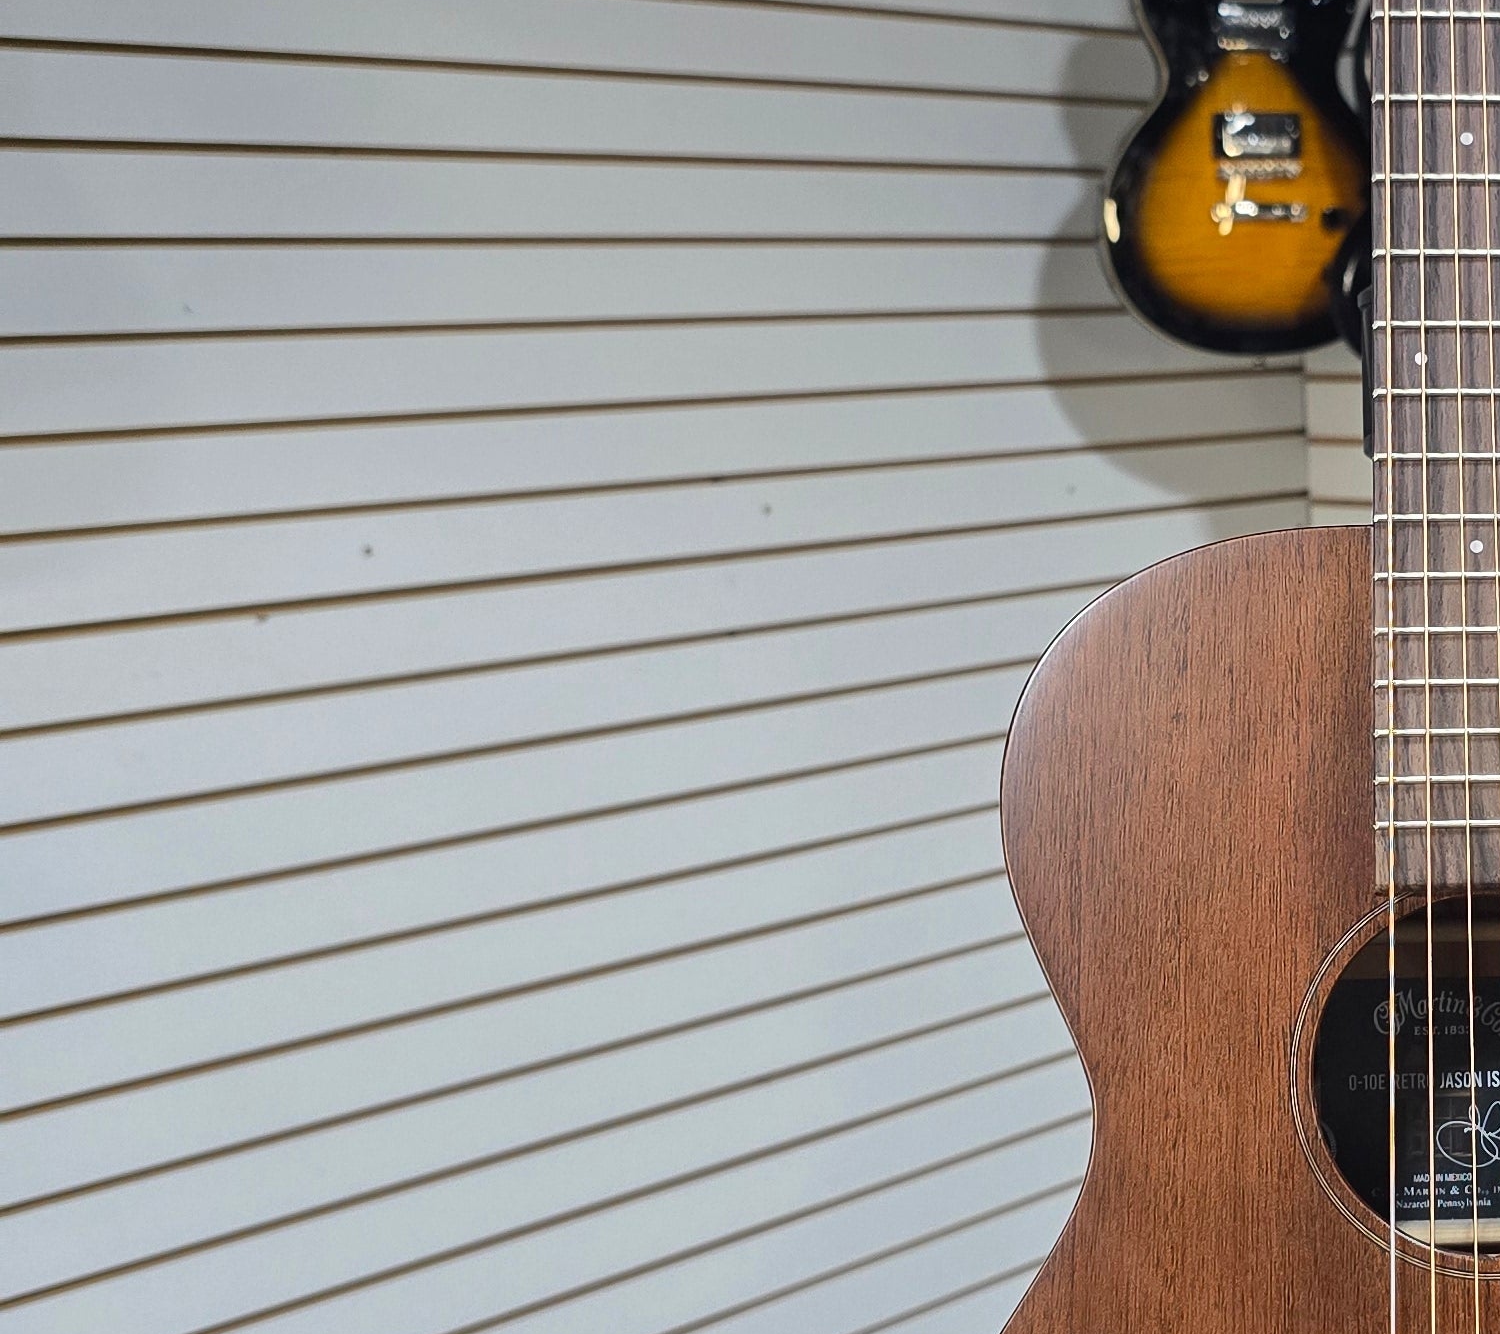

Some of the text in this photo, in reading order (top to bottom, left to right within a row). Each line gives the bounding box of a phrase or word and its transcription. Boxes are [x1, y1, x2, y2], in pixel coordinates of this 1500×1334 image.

[1394, 1071, 1434, 1090] RETR
[1438, 1069, 1483, 1089] JASON
[1449, 1185, 1461, 1196] &
